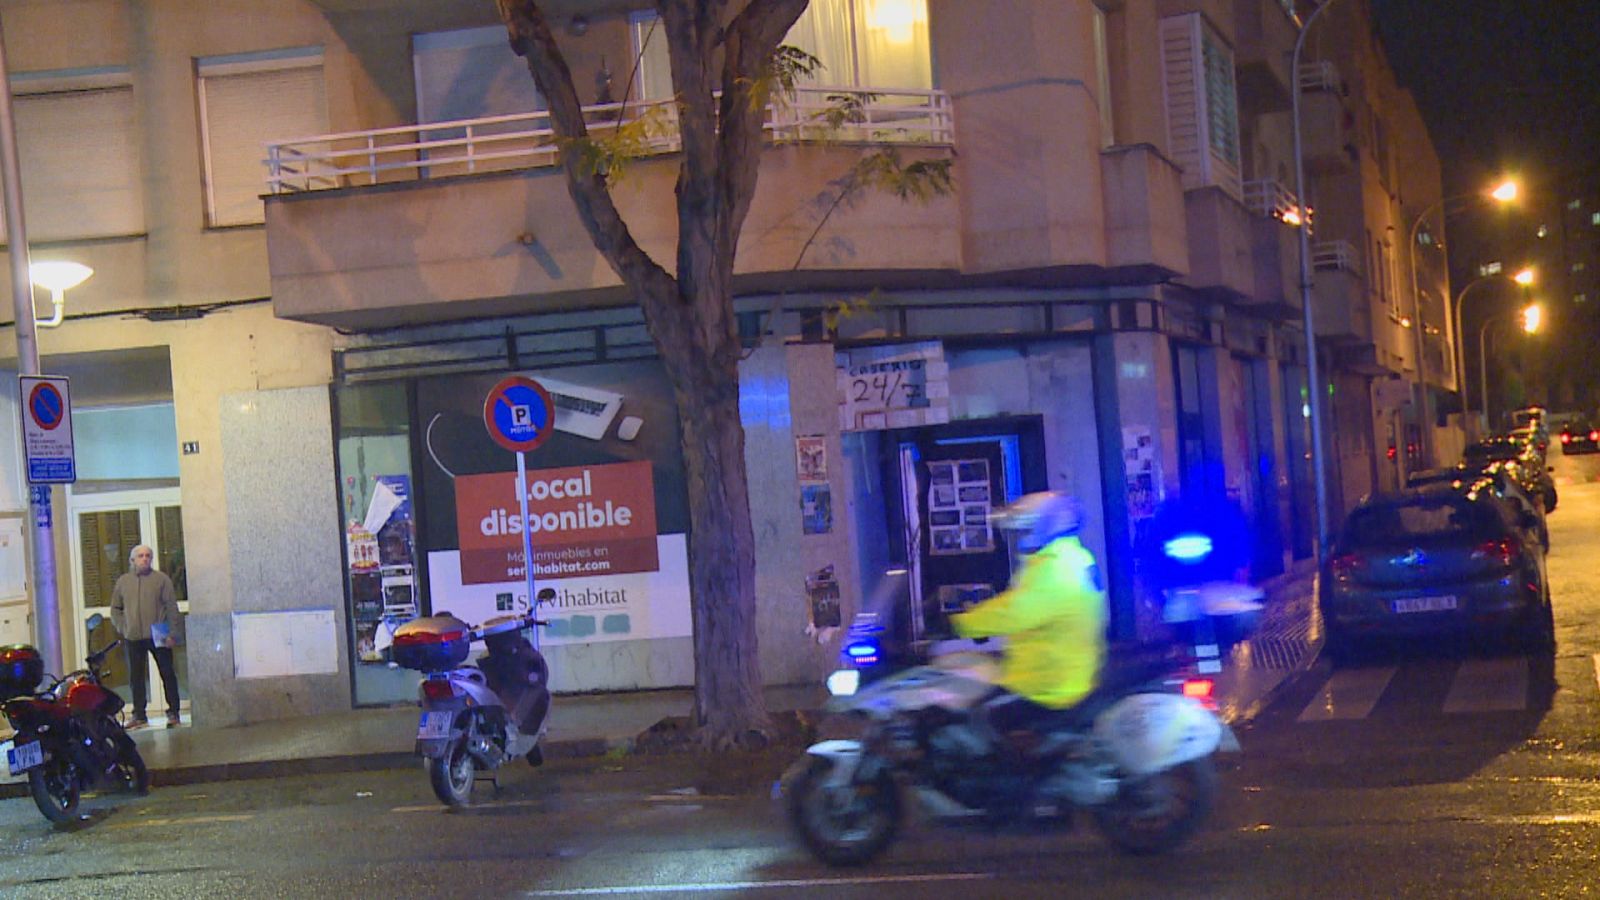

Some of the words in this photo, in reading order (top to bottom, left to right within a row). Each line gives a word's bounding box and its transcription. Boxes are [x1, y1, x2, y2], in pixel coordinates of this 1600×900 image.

[853, 373, 921, 408] 24/7
[515, 408, 526, 423] P
[184, 442, 197, 454] 41
[533, 547, 591, 561] inmuebles
[593, 546, 609, 557] en
[507, 561, 610, 576] serihabitat.com
